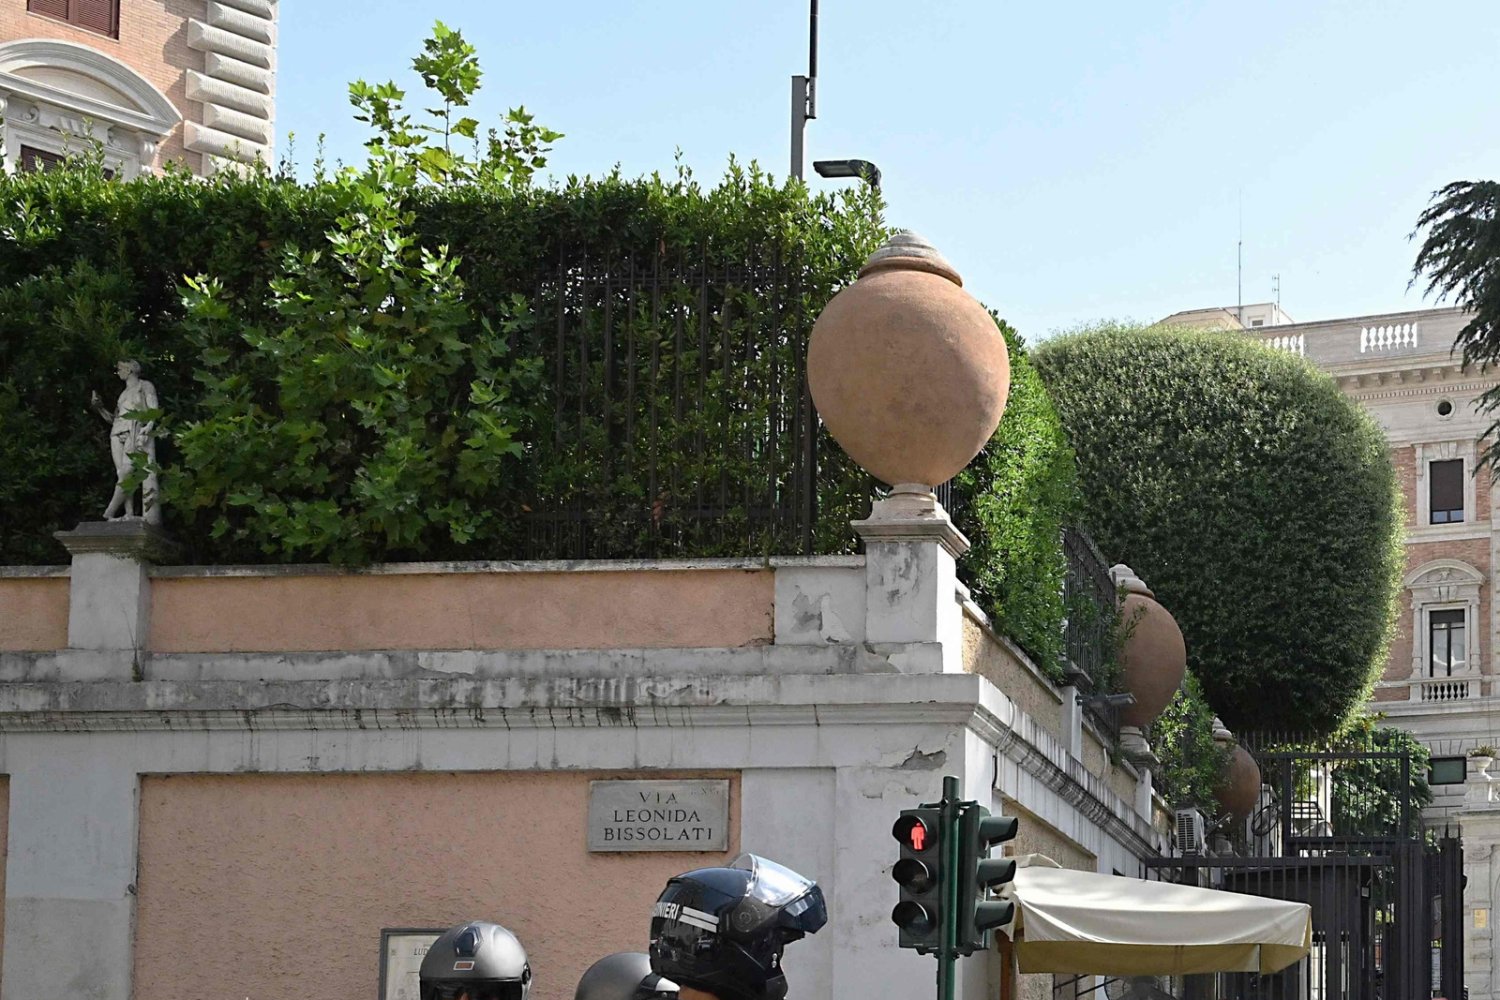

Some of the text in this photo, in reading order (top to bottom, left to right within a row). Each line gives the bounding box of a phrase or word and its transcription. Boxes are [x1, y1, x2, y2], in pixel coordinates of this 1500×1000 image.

[639, 791, 678, 804] VIA
[613, 809, 701, 823] LEONIDA
[603, 827, 713, 841] BISSOLATI
